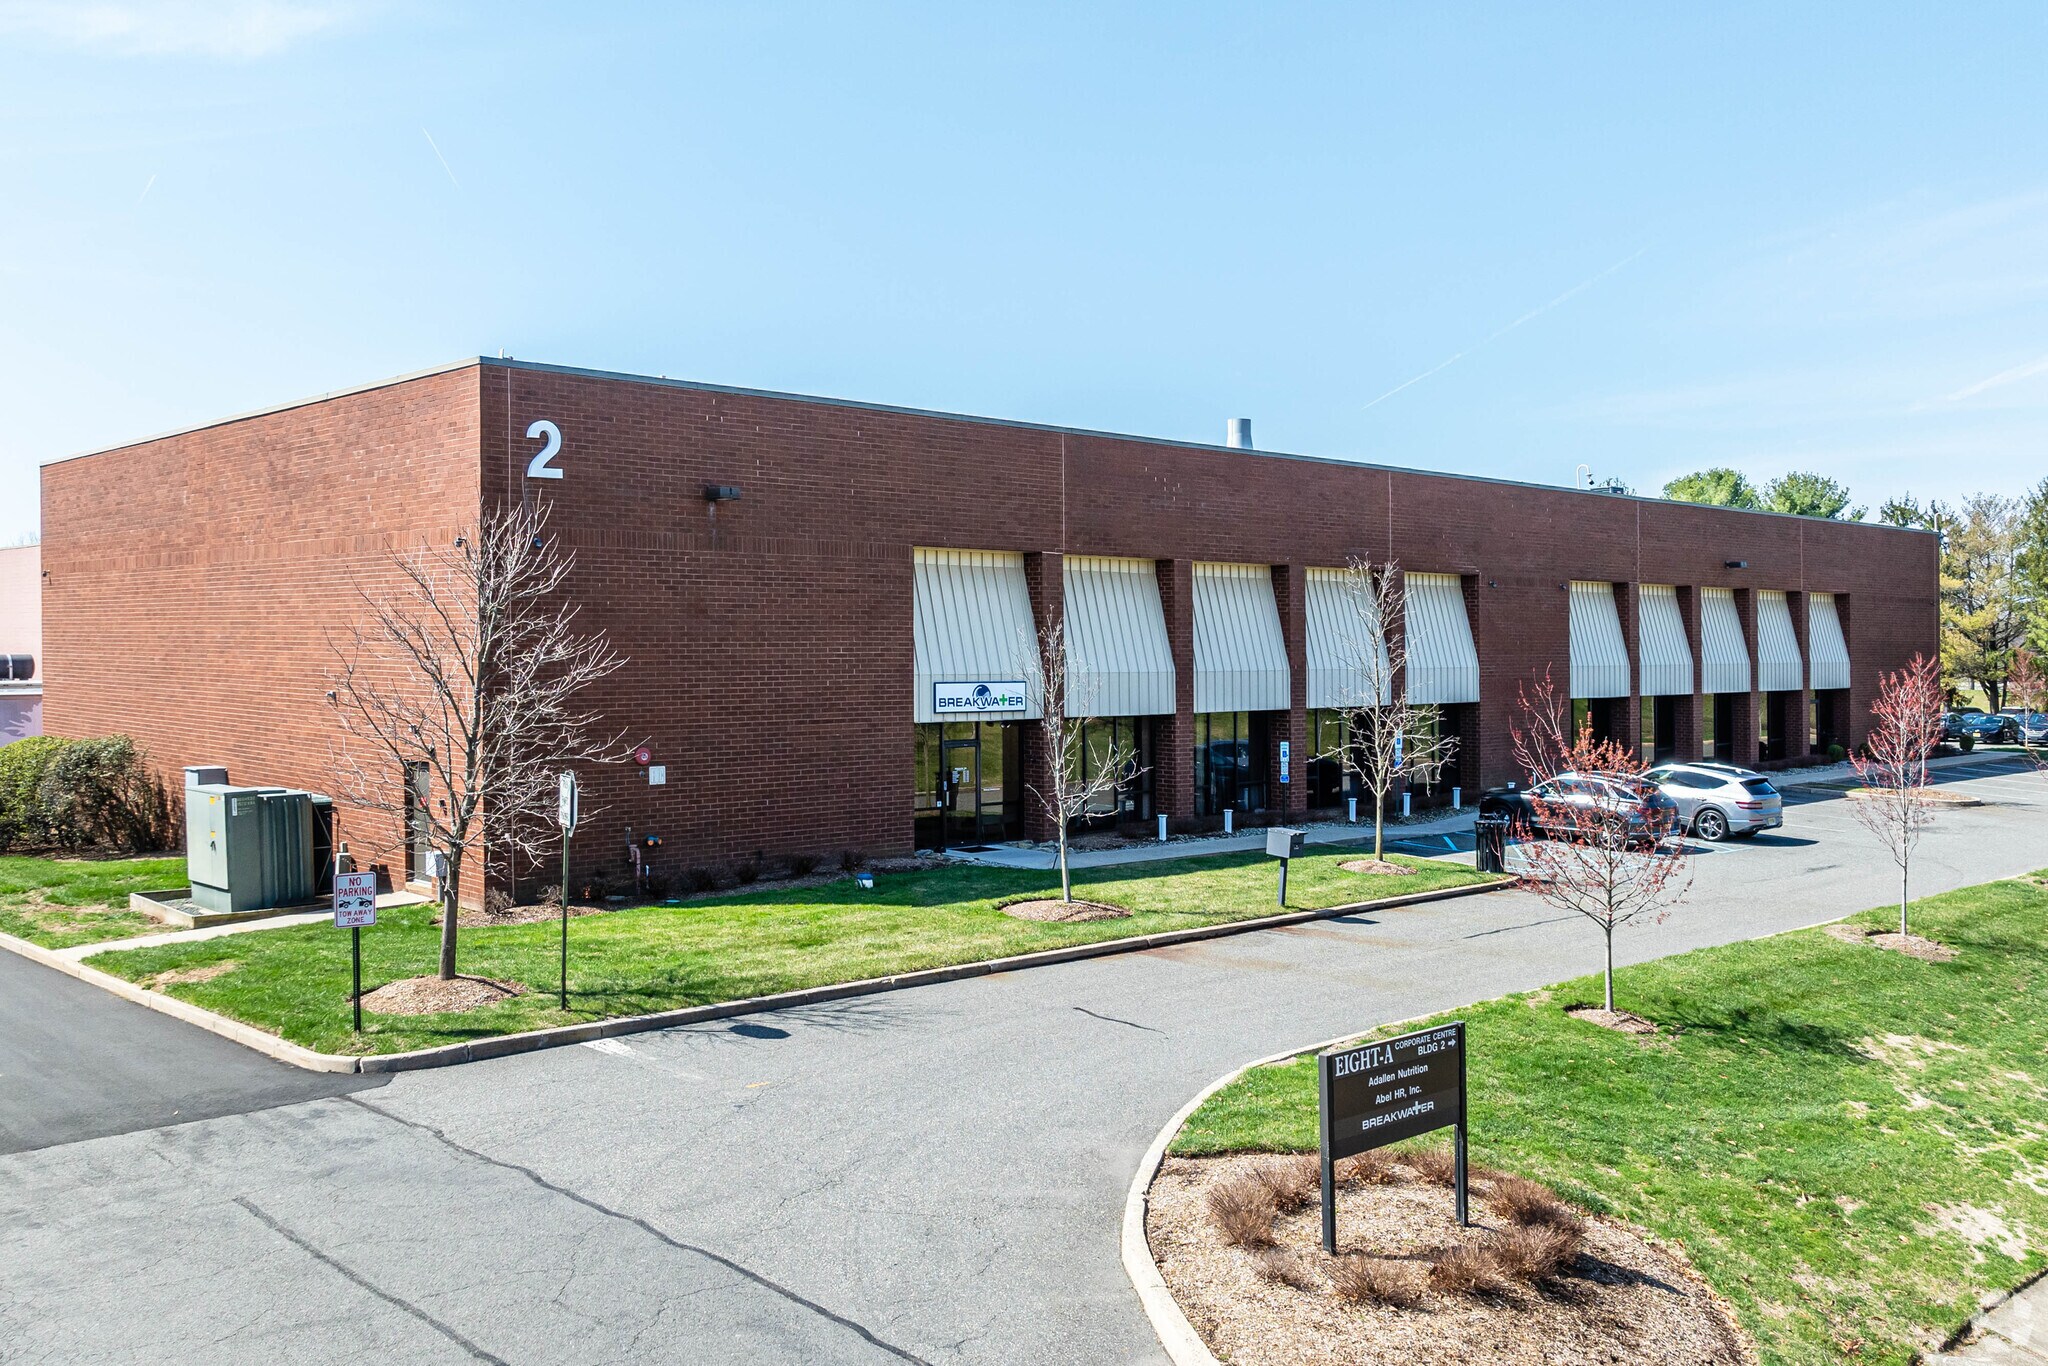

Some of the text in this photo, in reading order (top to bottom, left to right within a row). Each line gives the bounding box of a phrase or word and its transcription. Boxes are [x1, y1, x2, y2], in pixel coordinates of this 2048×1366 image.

[526, 419, 563, 478] 2
[939, 694, 1023, 707] BREAKWATER
[349, 876, 361, 886] NO
[338, 886, 373, 897] PARKING
[339, 909, 372, 918] TOW AWAY
[1395, 1028, 1456, 1050] CORPORATE CENTRE
[1418, 1040, 1446, 1056] BLDG 2
[1335, 1045, 1393, 1077] EIGHT-A
[1368, 1064, 1428, 1087] Adallen Nutrition
[1375, 1085, 1422, 1105] Abel HR, Inc.
[1362, 1101, 1434, 1130] BREAKWATER
